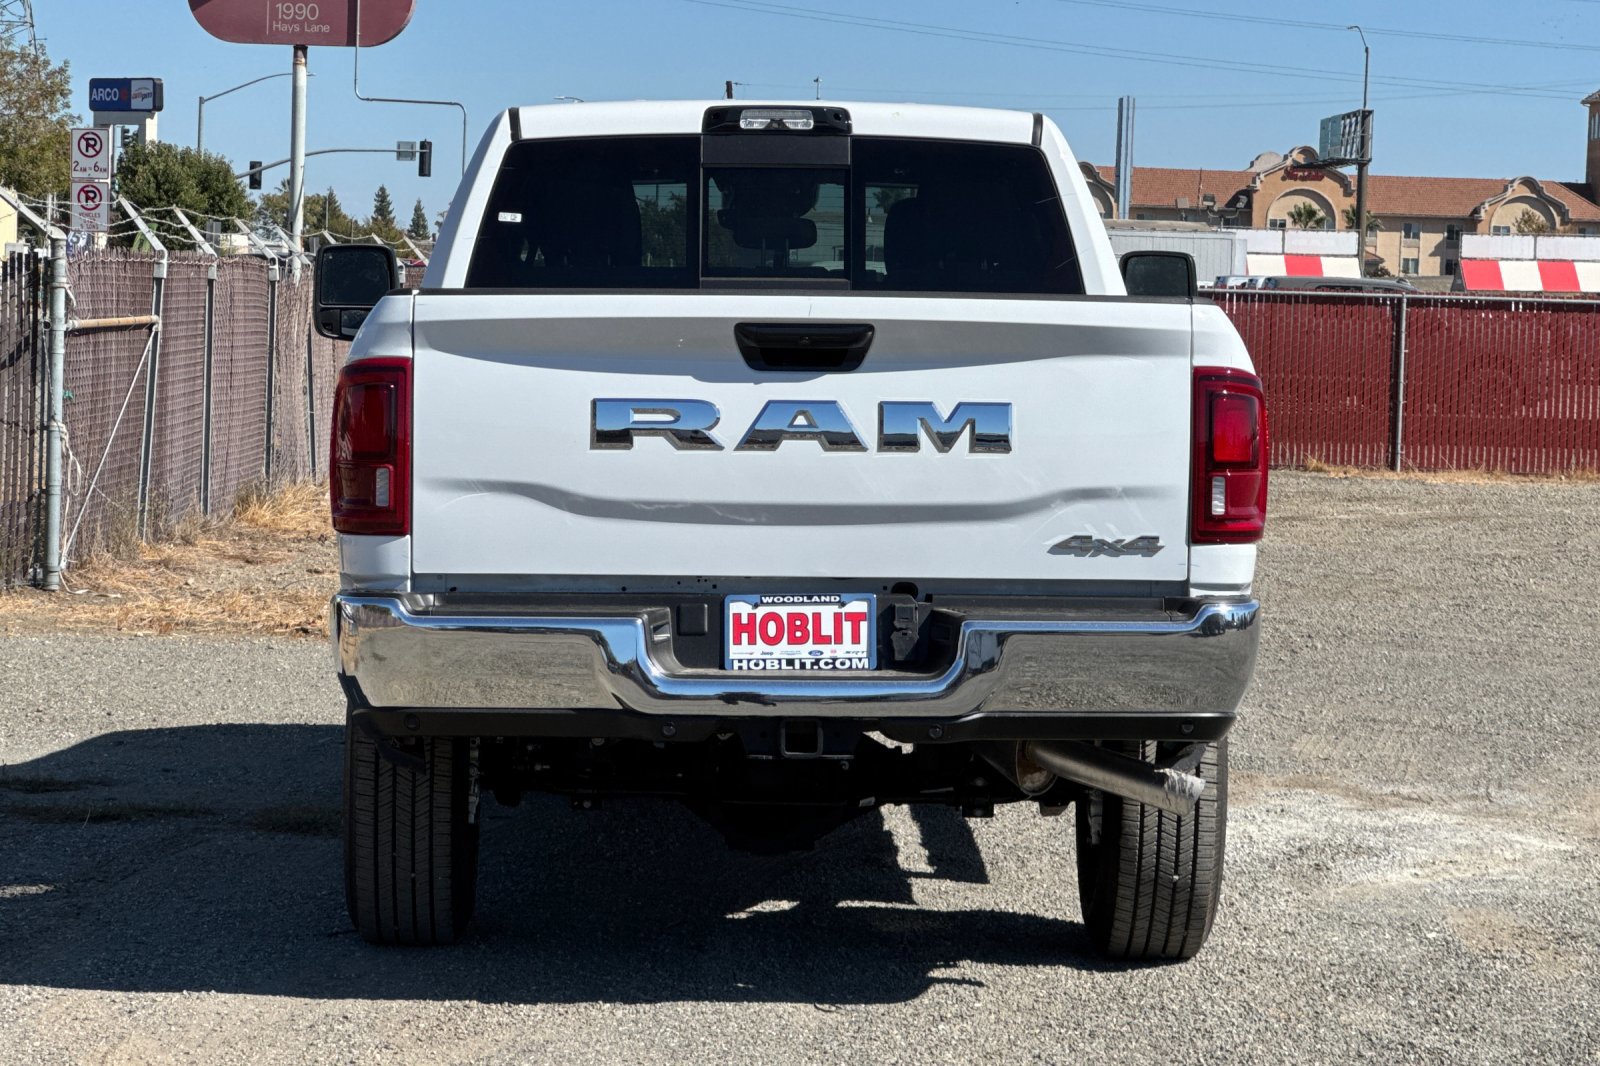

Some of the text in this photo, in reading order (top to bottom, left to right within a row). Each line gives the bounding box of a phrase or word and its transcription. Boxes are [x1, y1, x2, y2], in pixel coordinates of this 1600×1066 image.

[275, 2, 319, 20] 1990
[272, 20, 330, 33] Hays Lane
[91, 87, 119, 101] ARCO
[589, 397, 1013, 454] RAM
[761, 595, 840, 603] WOODLAND
[732, 611, 867, 646] HOBLIT
[732, 658, 869, 670] HOBLIT.COM
